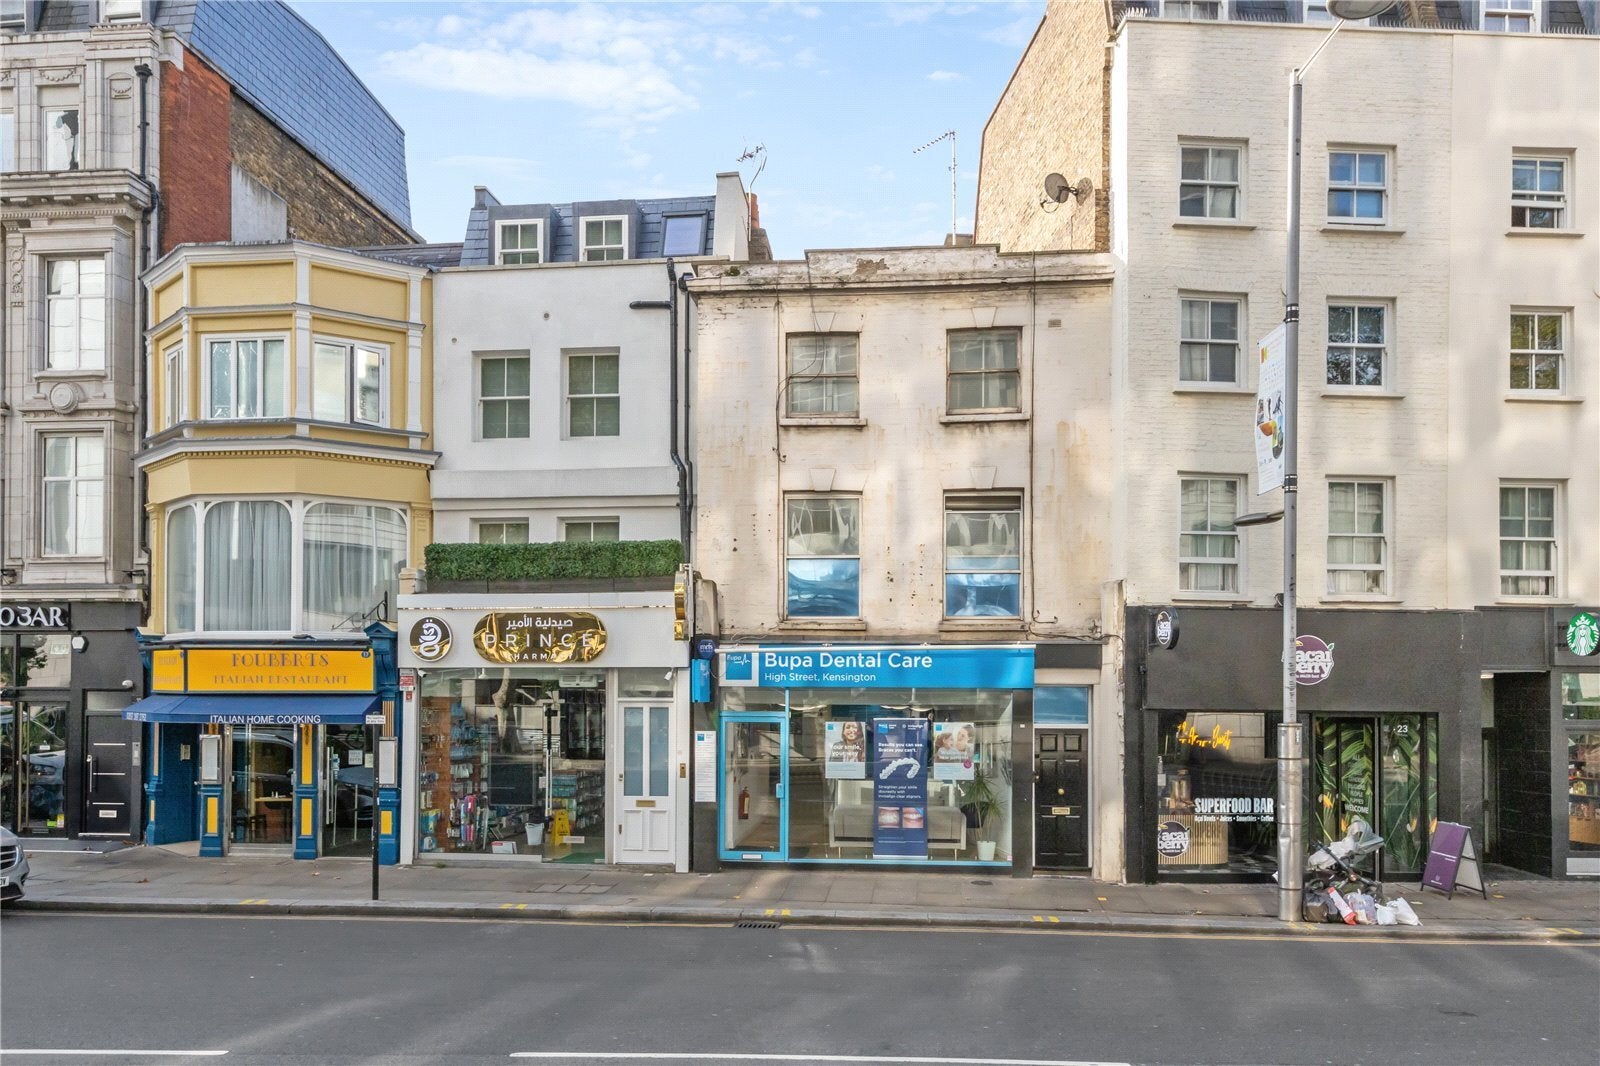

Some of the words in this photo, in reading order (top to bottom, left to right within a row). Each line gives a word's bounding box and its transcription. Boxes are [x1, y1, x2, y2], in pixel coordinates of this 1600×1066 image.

[506, 614, 533, 630] الأمير
[535, 617, 573, 630] صيدلية
[485, 633, 593, 648] PRINCE
[232, 653, 329, 667] FOUBERTS
[764, 653, 813, 671] Bupa
[819, 652, 881, 668] Dental
[888, 653, 933, 668] Care
[214, 674, 263, 684] ITALIAN
[268, 674, 347, 685] RESTAURANT
[764, 673, 786, 682] High
[789, 673, 820, 682] Street,
[823, 673, 876, 682] Kensington
[210, 715, 244, 724] ITALIAN
[247, 715, 275, 724] HOME
[277, 715, 321, 724] COOKING
[1397, 725, 1408, 733] 23
[1194, 797, 1252, 813] SUPERFOOD
[1253, 797, 1274, 813] BAR
[1345, 803, 1369, 814] WELCOME
